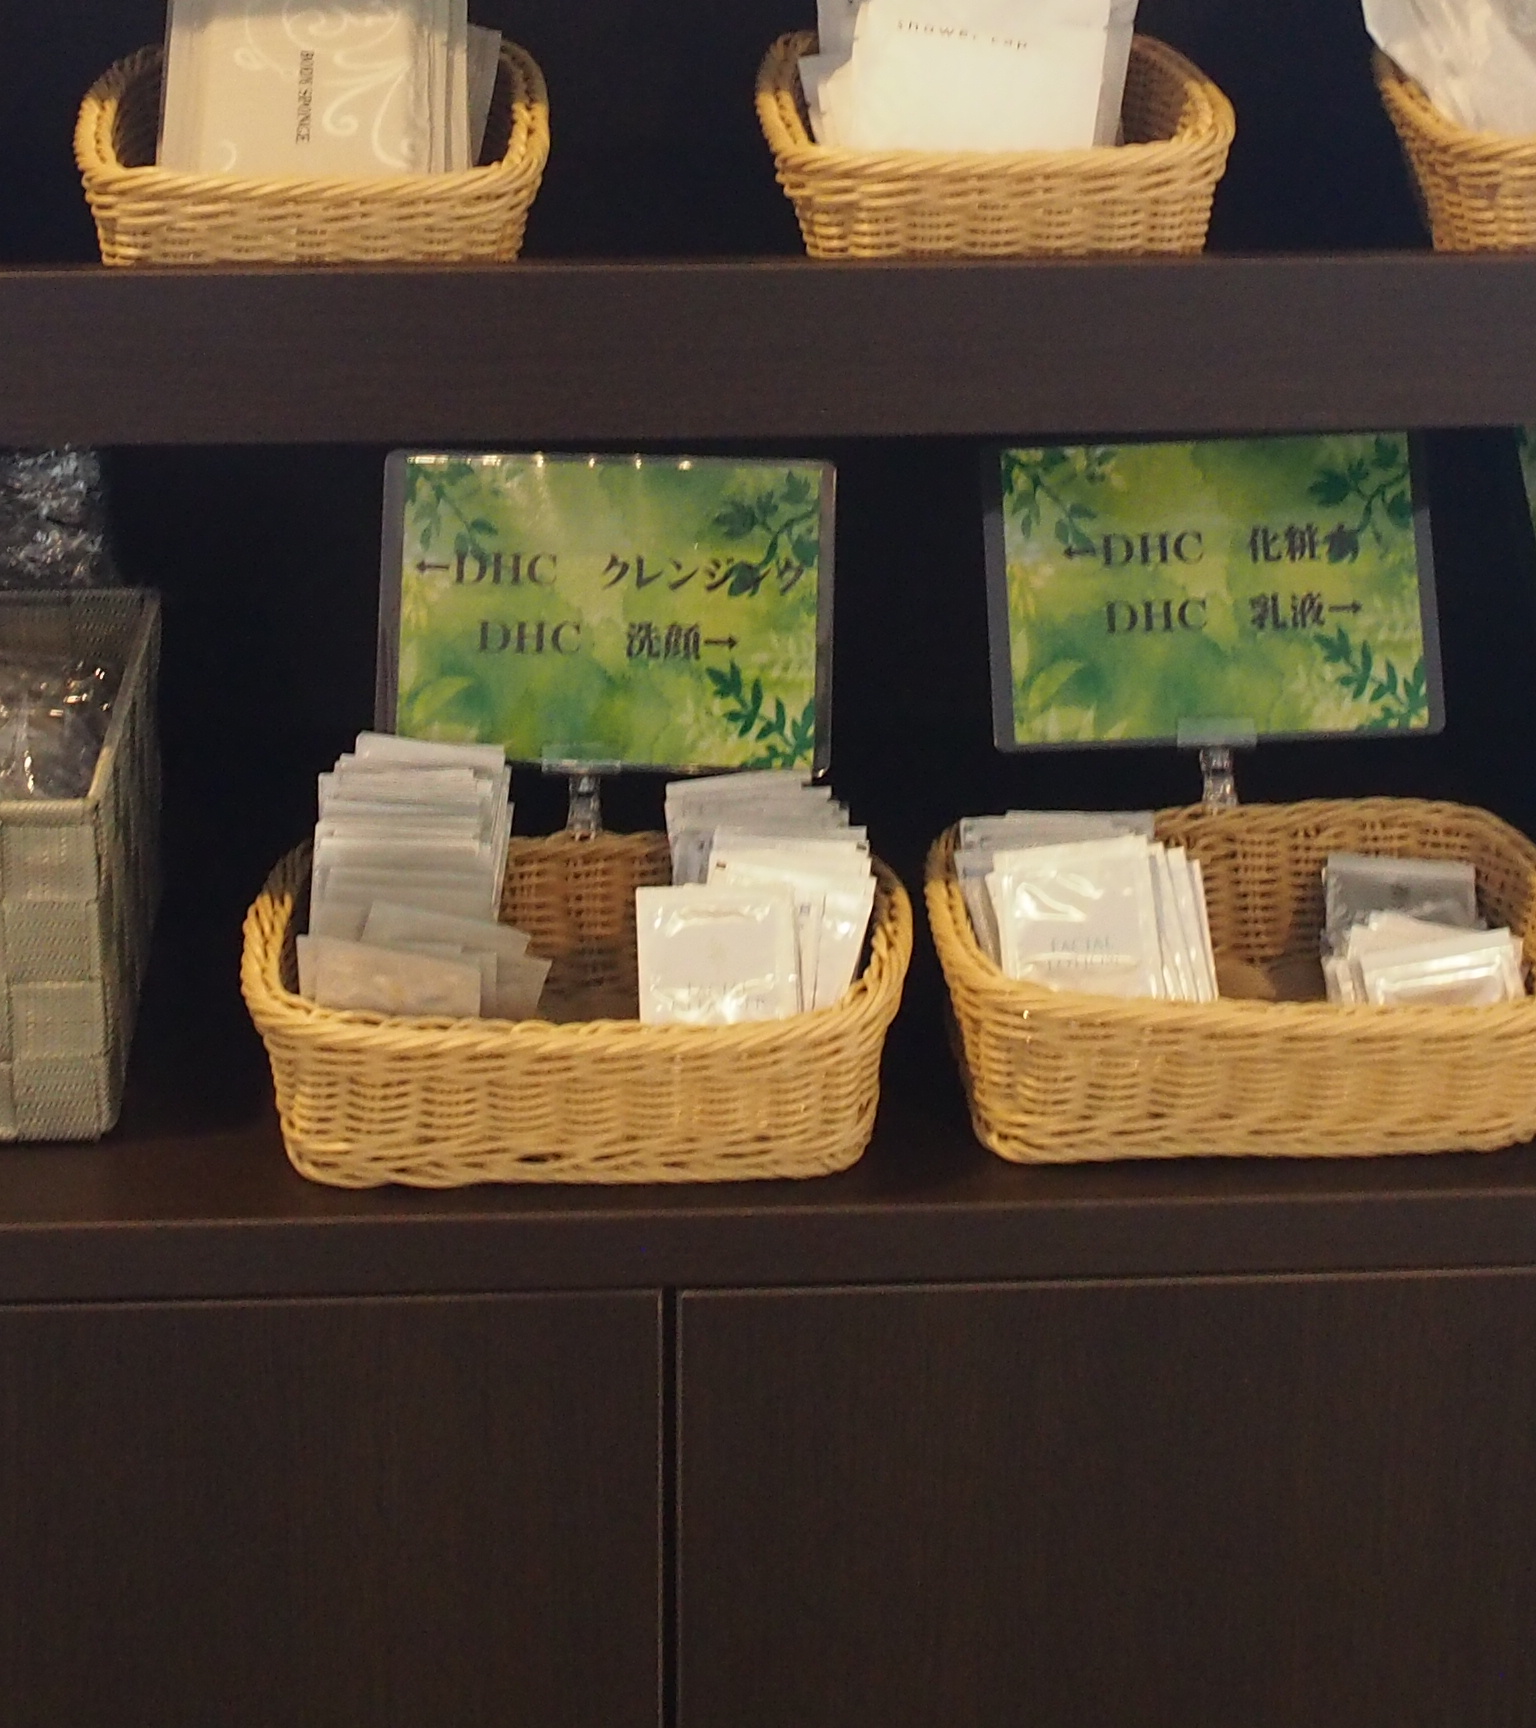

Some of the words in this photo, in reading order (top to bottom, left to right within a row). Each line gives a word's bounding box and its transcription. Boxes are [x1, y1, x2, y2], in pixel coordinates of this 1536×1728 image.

[1103, 530, 1205, 568] DHC
[1248, 523, 1360, 563] 化粧水
[454, 551, 558, 587] DHC
[600, 552, 806, 597] クレンジング
[1106, 598, 1210, 636] DHC
[1249, 591, 1327, 629] 乳液
[477, 619, 583, 656] DHC
[626, 621, 701, 661] 洗顔
